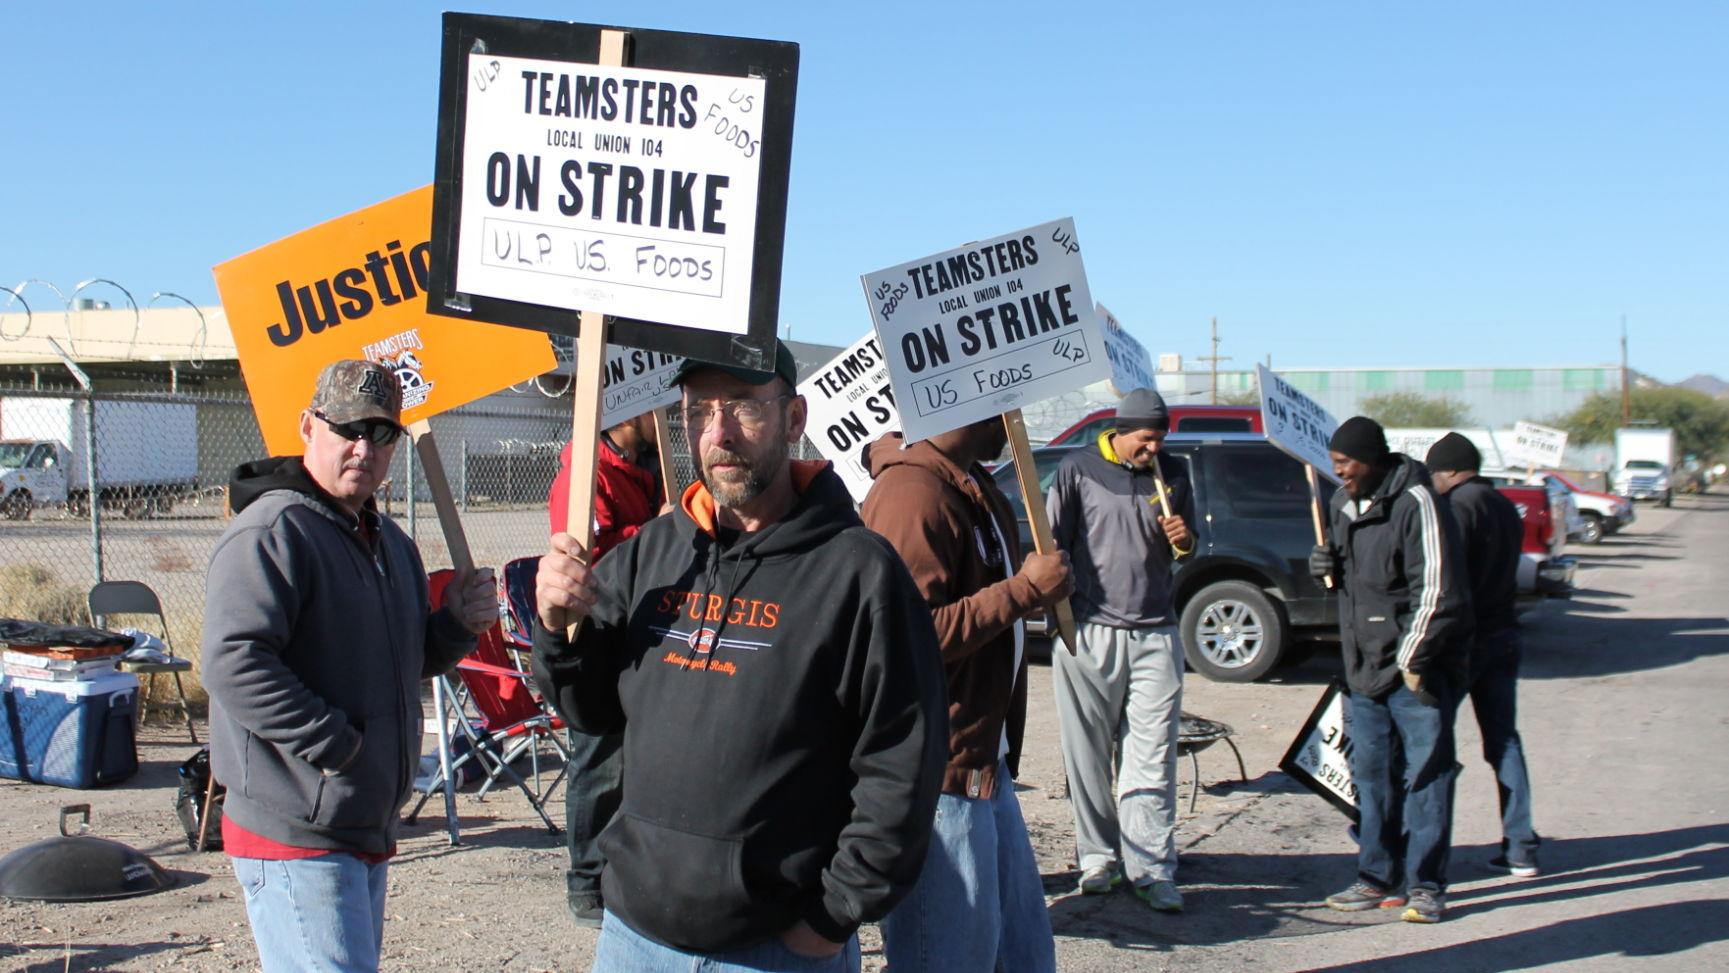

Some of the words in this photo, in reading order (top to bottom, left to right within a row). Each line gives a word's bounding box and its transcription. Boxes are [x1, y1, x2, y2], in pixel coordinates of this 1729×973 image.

[473, 60, 501, 92] ULP
[521, 71, 698, 129] TEAMSTERS
[728, 88, 754, 113] US
[547, 129, 583, 149] LOCAL
[595, 133, 631, 154] UNION
[641, 138, 663, 157] 104
[704, 103, 760, 158] FOODS
[486, 151, 541, 212] ON
[558, 159, 730, 235] STRIKE
[1052, 227, 1080, 255] ULP
[635, 245, 713, 281] FOODS
[907, 235, 1039, 300] TEAMSTERS
[875, 281, 891, 301] US
[881, 282, 909, 321] FOODS
[939, 295, 969, 315] LOCAL
[974, 281, 1002, 304] UNION
[1007, 278, 1024, 293] 104
[361, 328, 424, 362] TEAMSTERS
[901, 323, 951, 374] ON
[957, 284, 1079, 357] STRIKE
[1052, 339, 1084, 362] ULP
[846, 383, 870, 403] LOCAL
[924, 380, 958, 409] US
[973, 364, 1033, 393] FOODS
[827, 411, 869, 452] ON
[657, 591, 780, 629] STURGIS
